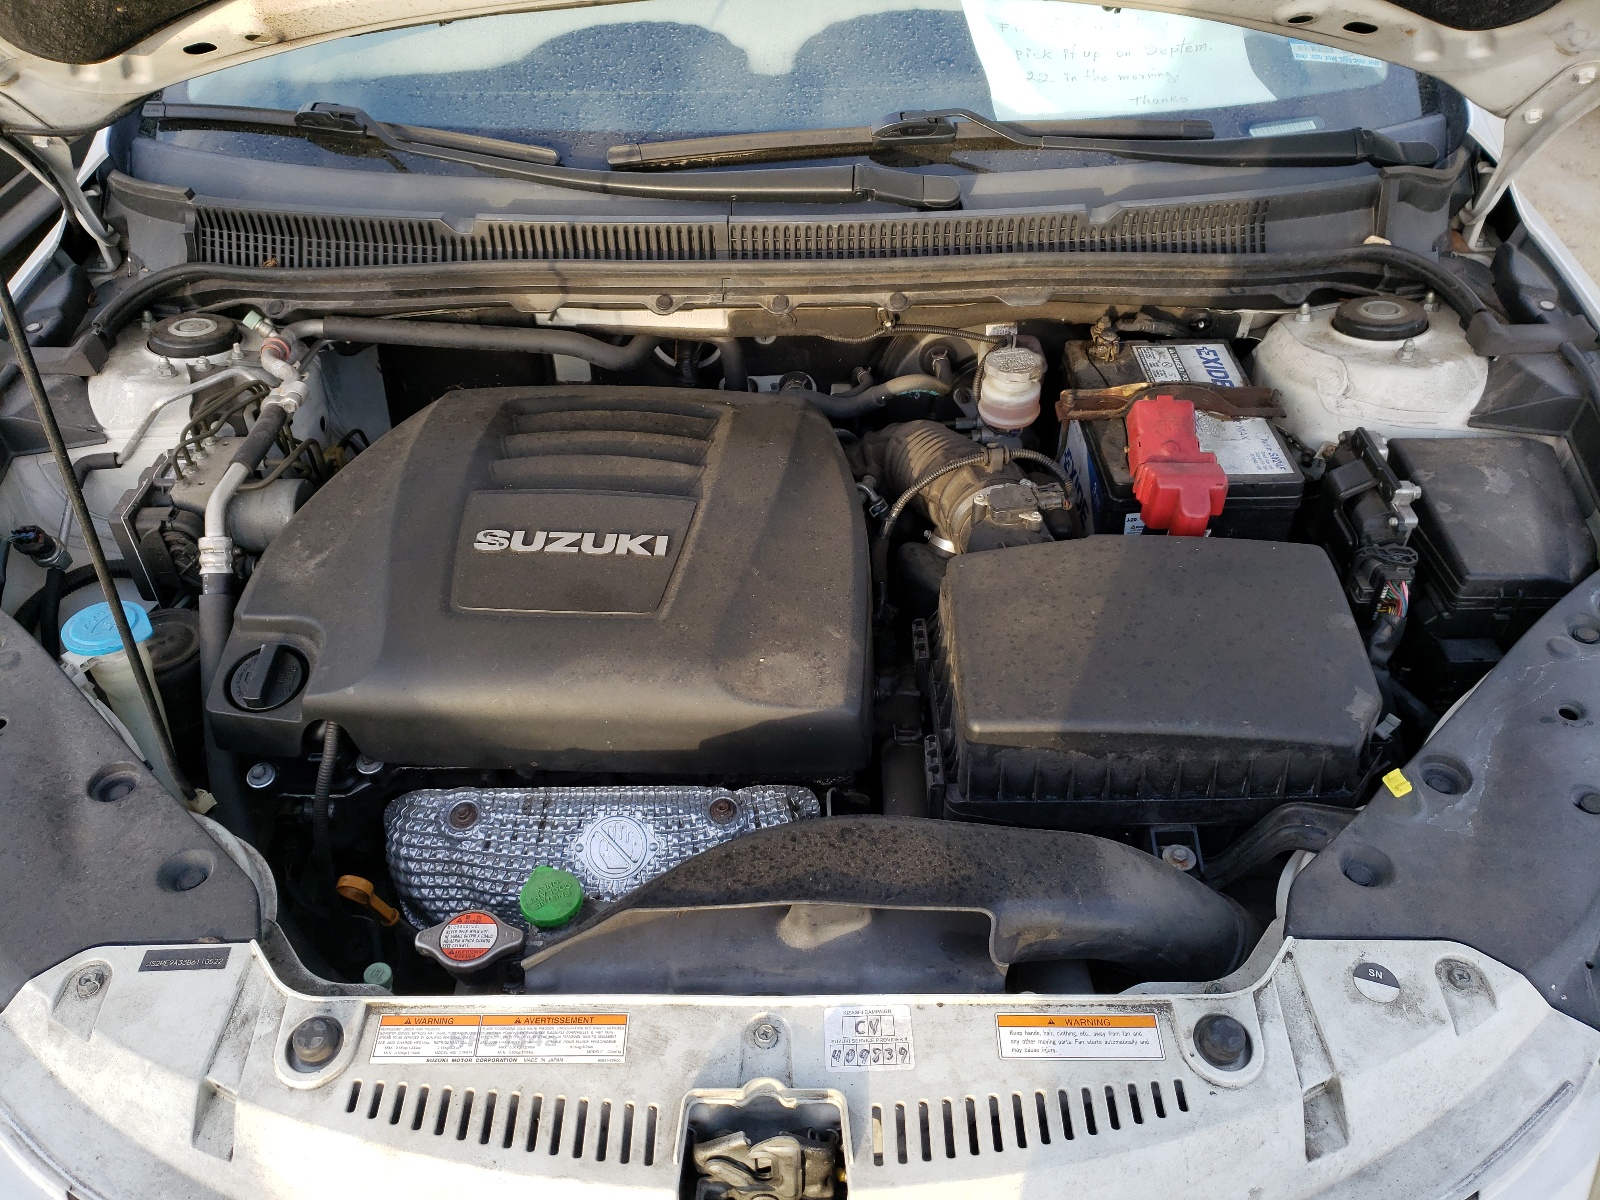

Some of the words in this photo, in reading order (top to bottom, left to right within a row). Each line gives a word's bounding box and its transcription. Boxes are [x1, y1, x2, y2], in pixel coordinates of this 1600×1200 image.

[1083, 50, 1101, 63] up
[1063, 72, 1077, 83] in
[1083, 68, 1108, 83] the
[1129, 95, 1189, 105] Thanks
[1195, 346, 1235, 388] EXIDE
[473, 529, 669, 557] SUZUKI
[538, 880, 560, 893] ONLY
[530, 883, 572, 904] COOLANT
[534, 890, 571, 910] ENGINE
[1368, 968, 1383, 980] SN
[414, 1017, 454, 1025] WARNING
[524, 1016, 595, 1024] AVERTISSEMENT
[1064, 1018, 1111, 1026] WARNING
[854, 1019, 880, 1035] CV
